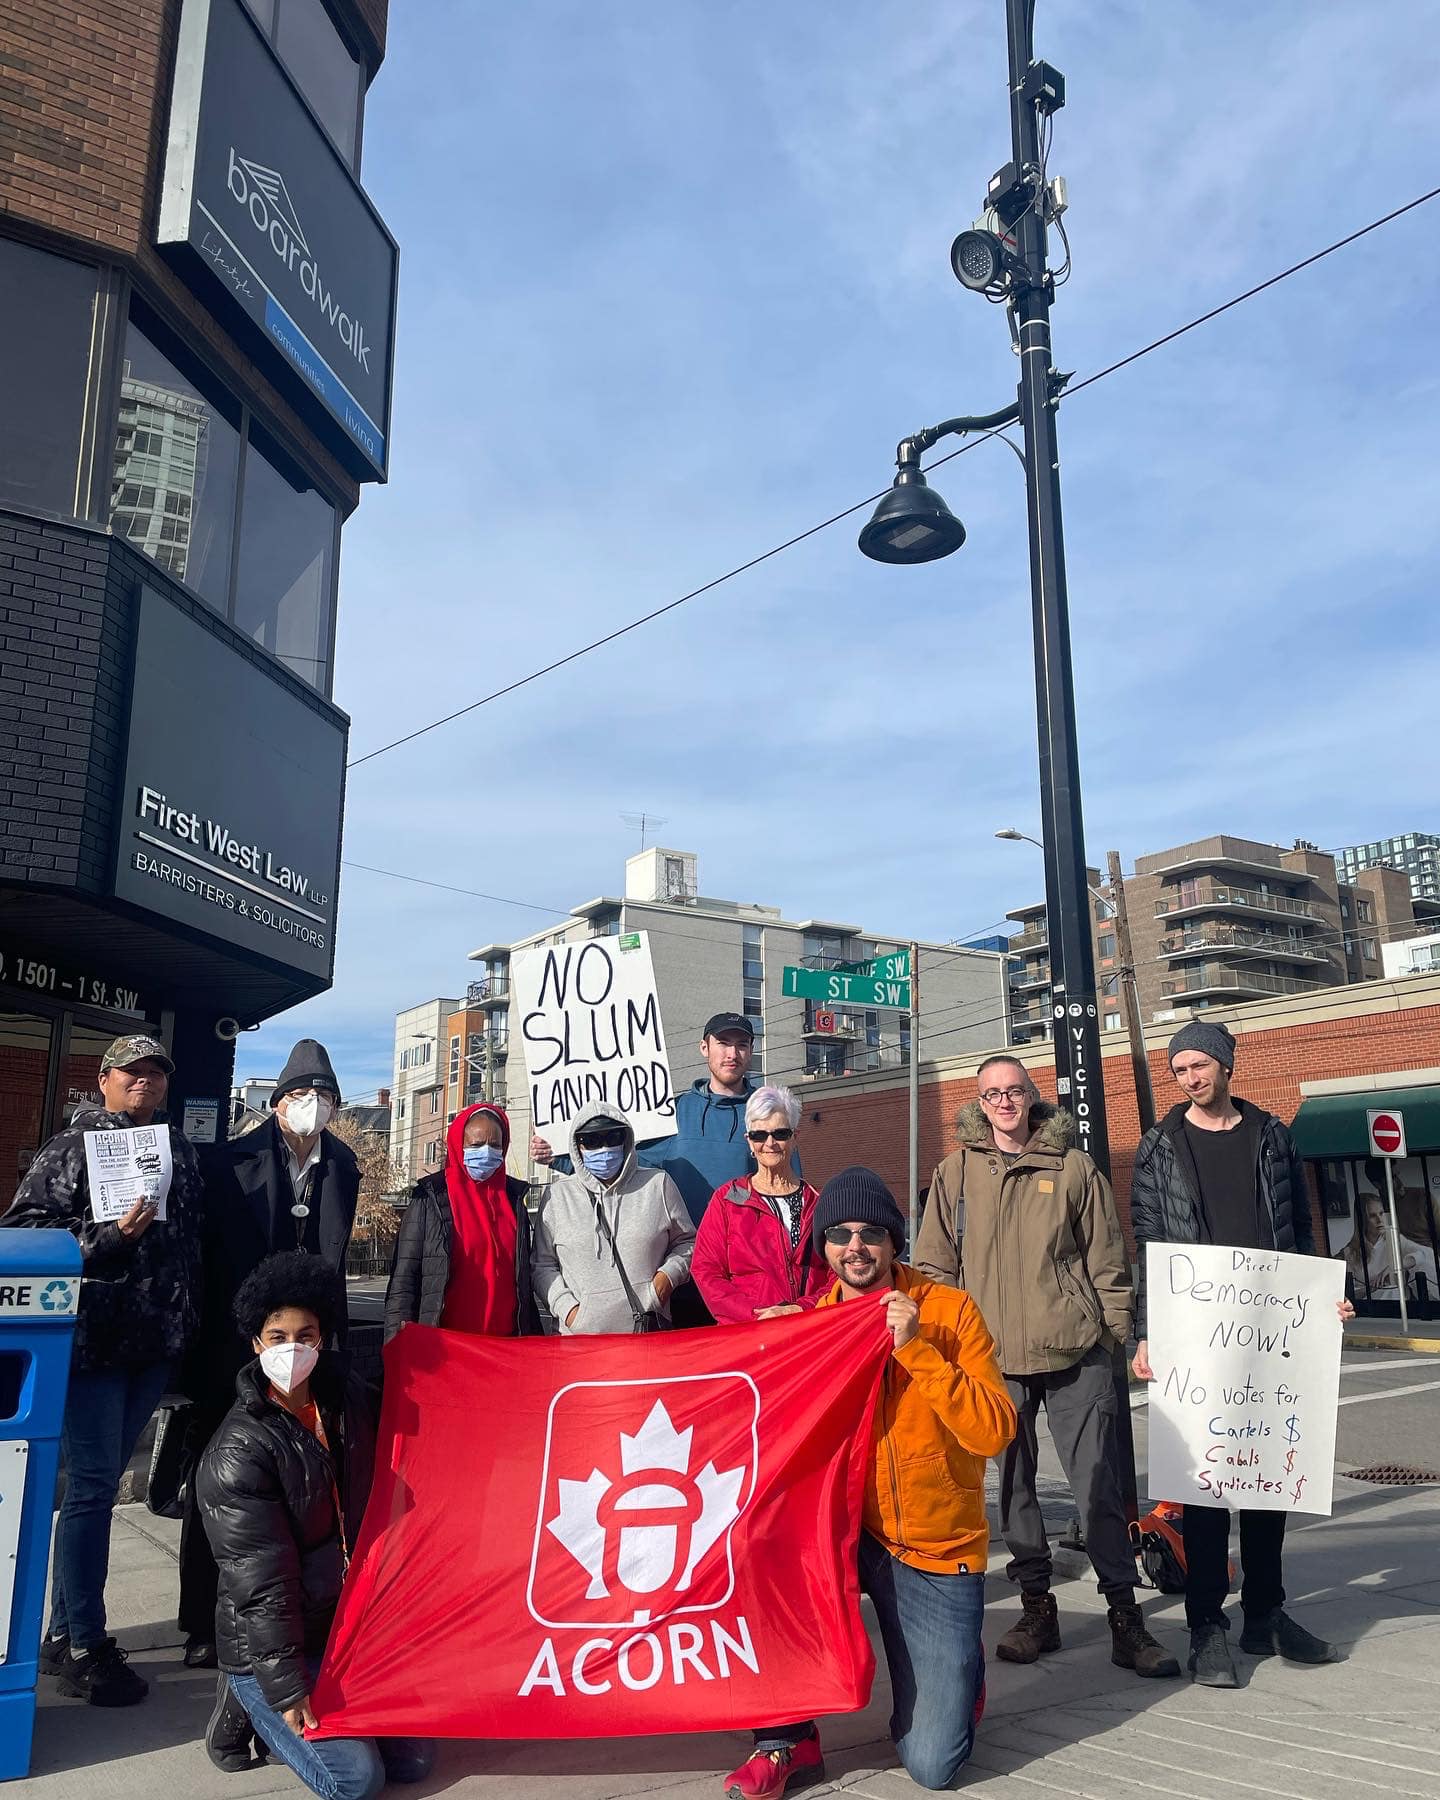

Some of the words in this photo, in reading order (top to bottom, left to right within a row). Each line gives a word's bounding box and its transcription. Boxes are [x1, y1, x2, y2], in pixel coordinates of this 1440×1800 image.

[227, 146, 371, 375] boardwalk
[271, 324, 326, 394] communities
[345, 407, 374, 456] living
[141, 786, 200, 844] First
[207, 820, 260, 875] West
[266, 852, 308, 896] Law
[311, 889, 328, 906] LLP
[136, 852, 235, 909] BARRISTERS
[238, 899, 248, 917] &
[253, 906, 325, 949] SOLICITORS
[17, 958, 56, 991] 1501
[79, 976, 85, 998] 1
[91, 980, 109, 1006] St.
[114, 987, 138, 1012] SW
[538, 942, 613, 1009] NO
[886, 955, 905, 979] SW
[791, 971, 797, 993] 1
[828, 976, 852, 999] ST
[873, 982, 901, 1006] SW
[523, 992, 662, 1076] SLUM
[68, 1088, 88, 1101] First
[95, 1132, 127, 1144] ACORN
[1232, 1250, 1282, 1273] Direct
[1169, 1253, 1311, 1329] Democracy
[1209, 1320, 1291, 1359] NOW!
[1164, 1366, 1207, 1405] No
[1223, 1372, 1265, 1406] votes
[1274, 1384, 1303, 1406] for
[1208, 1416, 1271, 1439] Cartels
[1282, 1414, 1301, 1445] $
[1205, 1445, 1260, 1467] Cabals
[1283, 1447, 1298, 1474] $
[1198, 1470, 1283, 1499] Syndicates
[1289, 1475, 1308, 1505] $
[517, 1616, 760, 1697] ACORN
